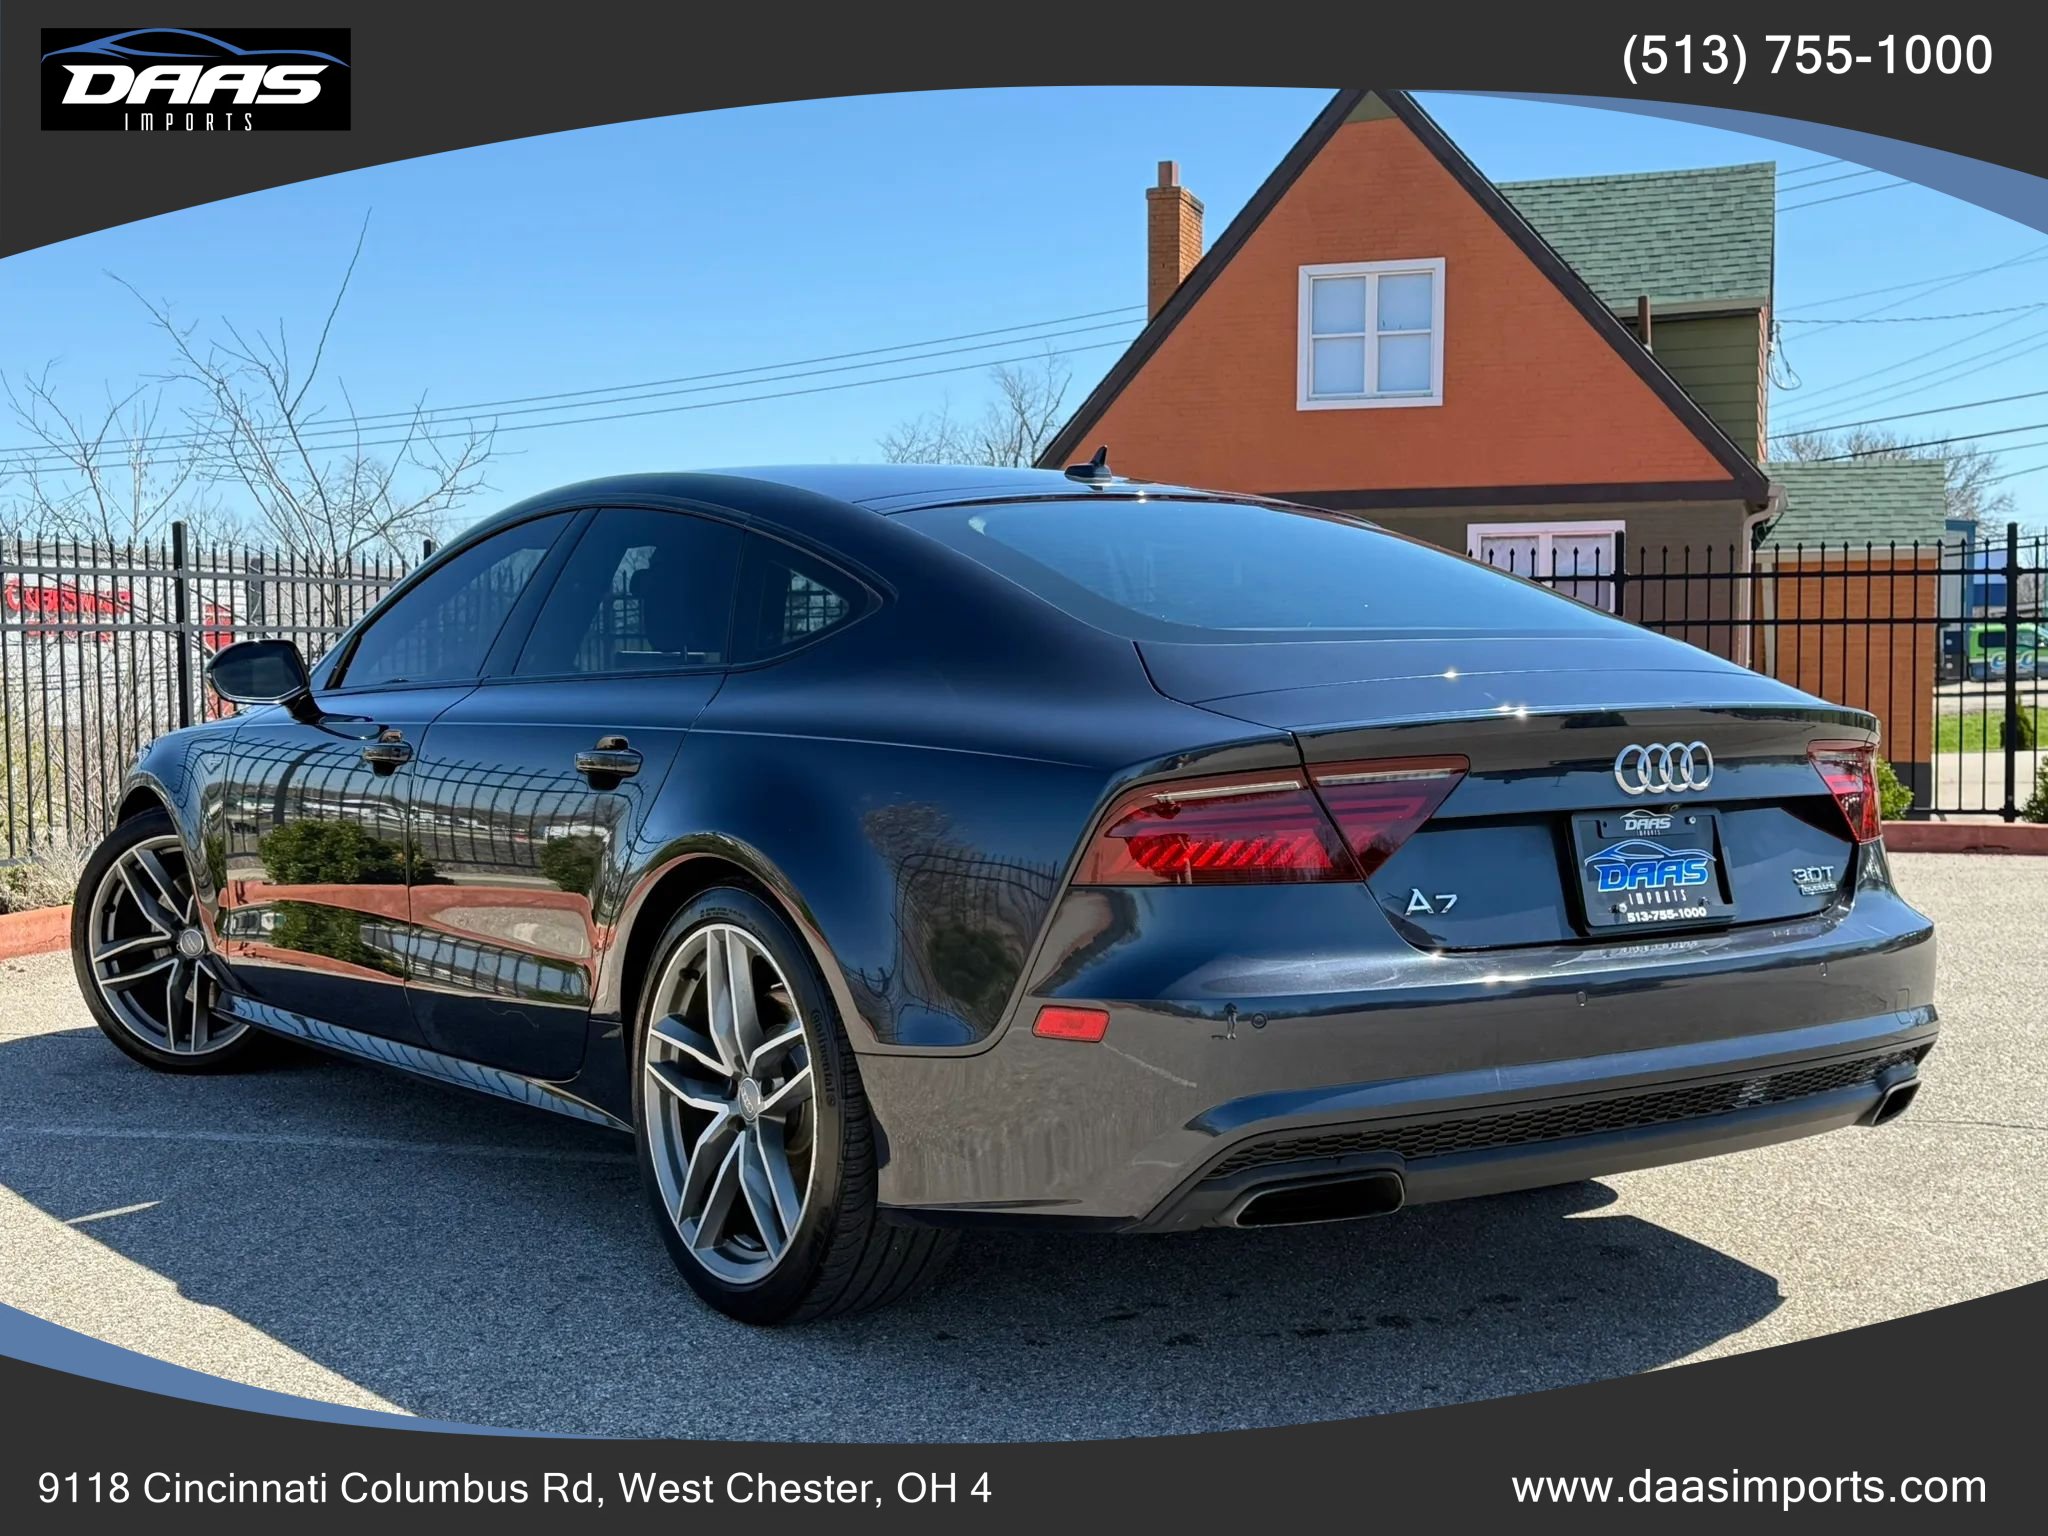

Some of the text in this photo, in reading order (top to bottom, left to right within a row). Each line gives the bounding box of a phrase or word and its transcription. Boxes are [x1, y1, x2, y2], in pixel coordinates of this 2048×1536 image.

[1624, 817, 1671, 831] DAAS
[1594, 857, 1709, 892] DAAS
[1405, 888, 1458, 916] A7
[1628, 889, 1687, 905] IMPORTS
[1627, 906, 1707, 923] 513-755-1000
